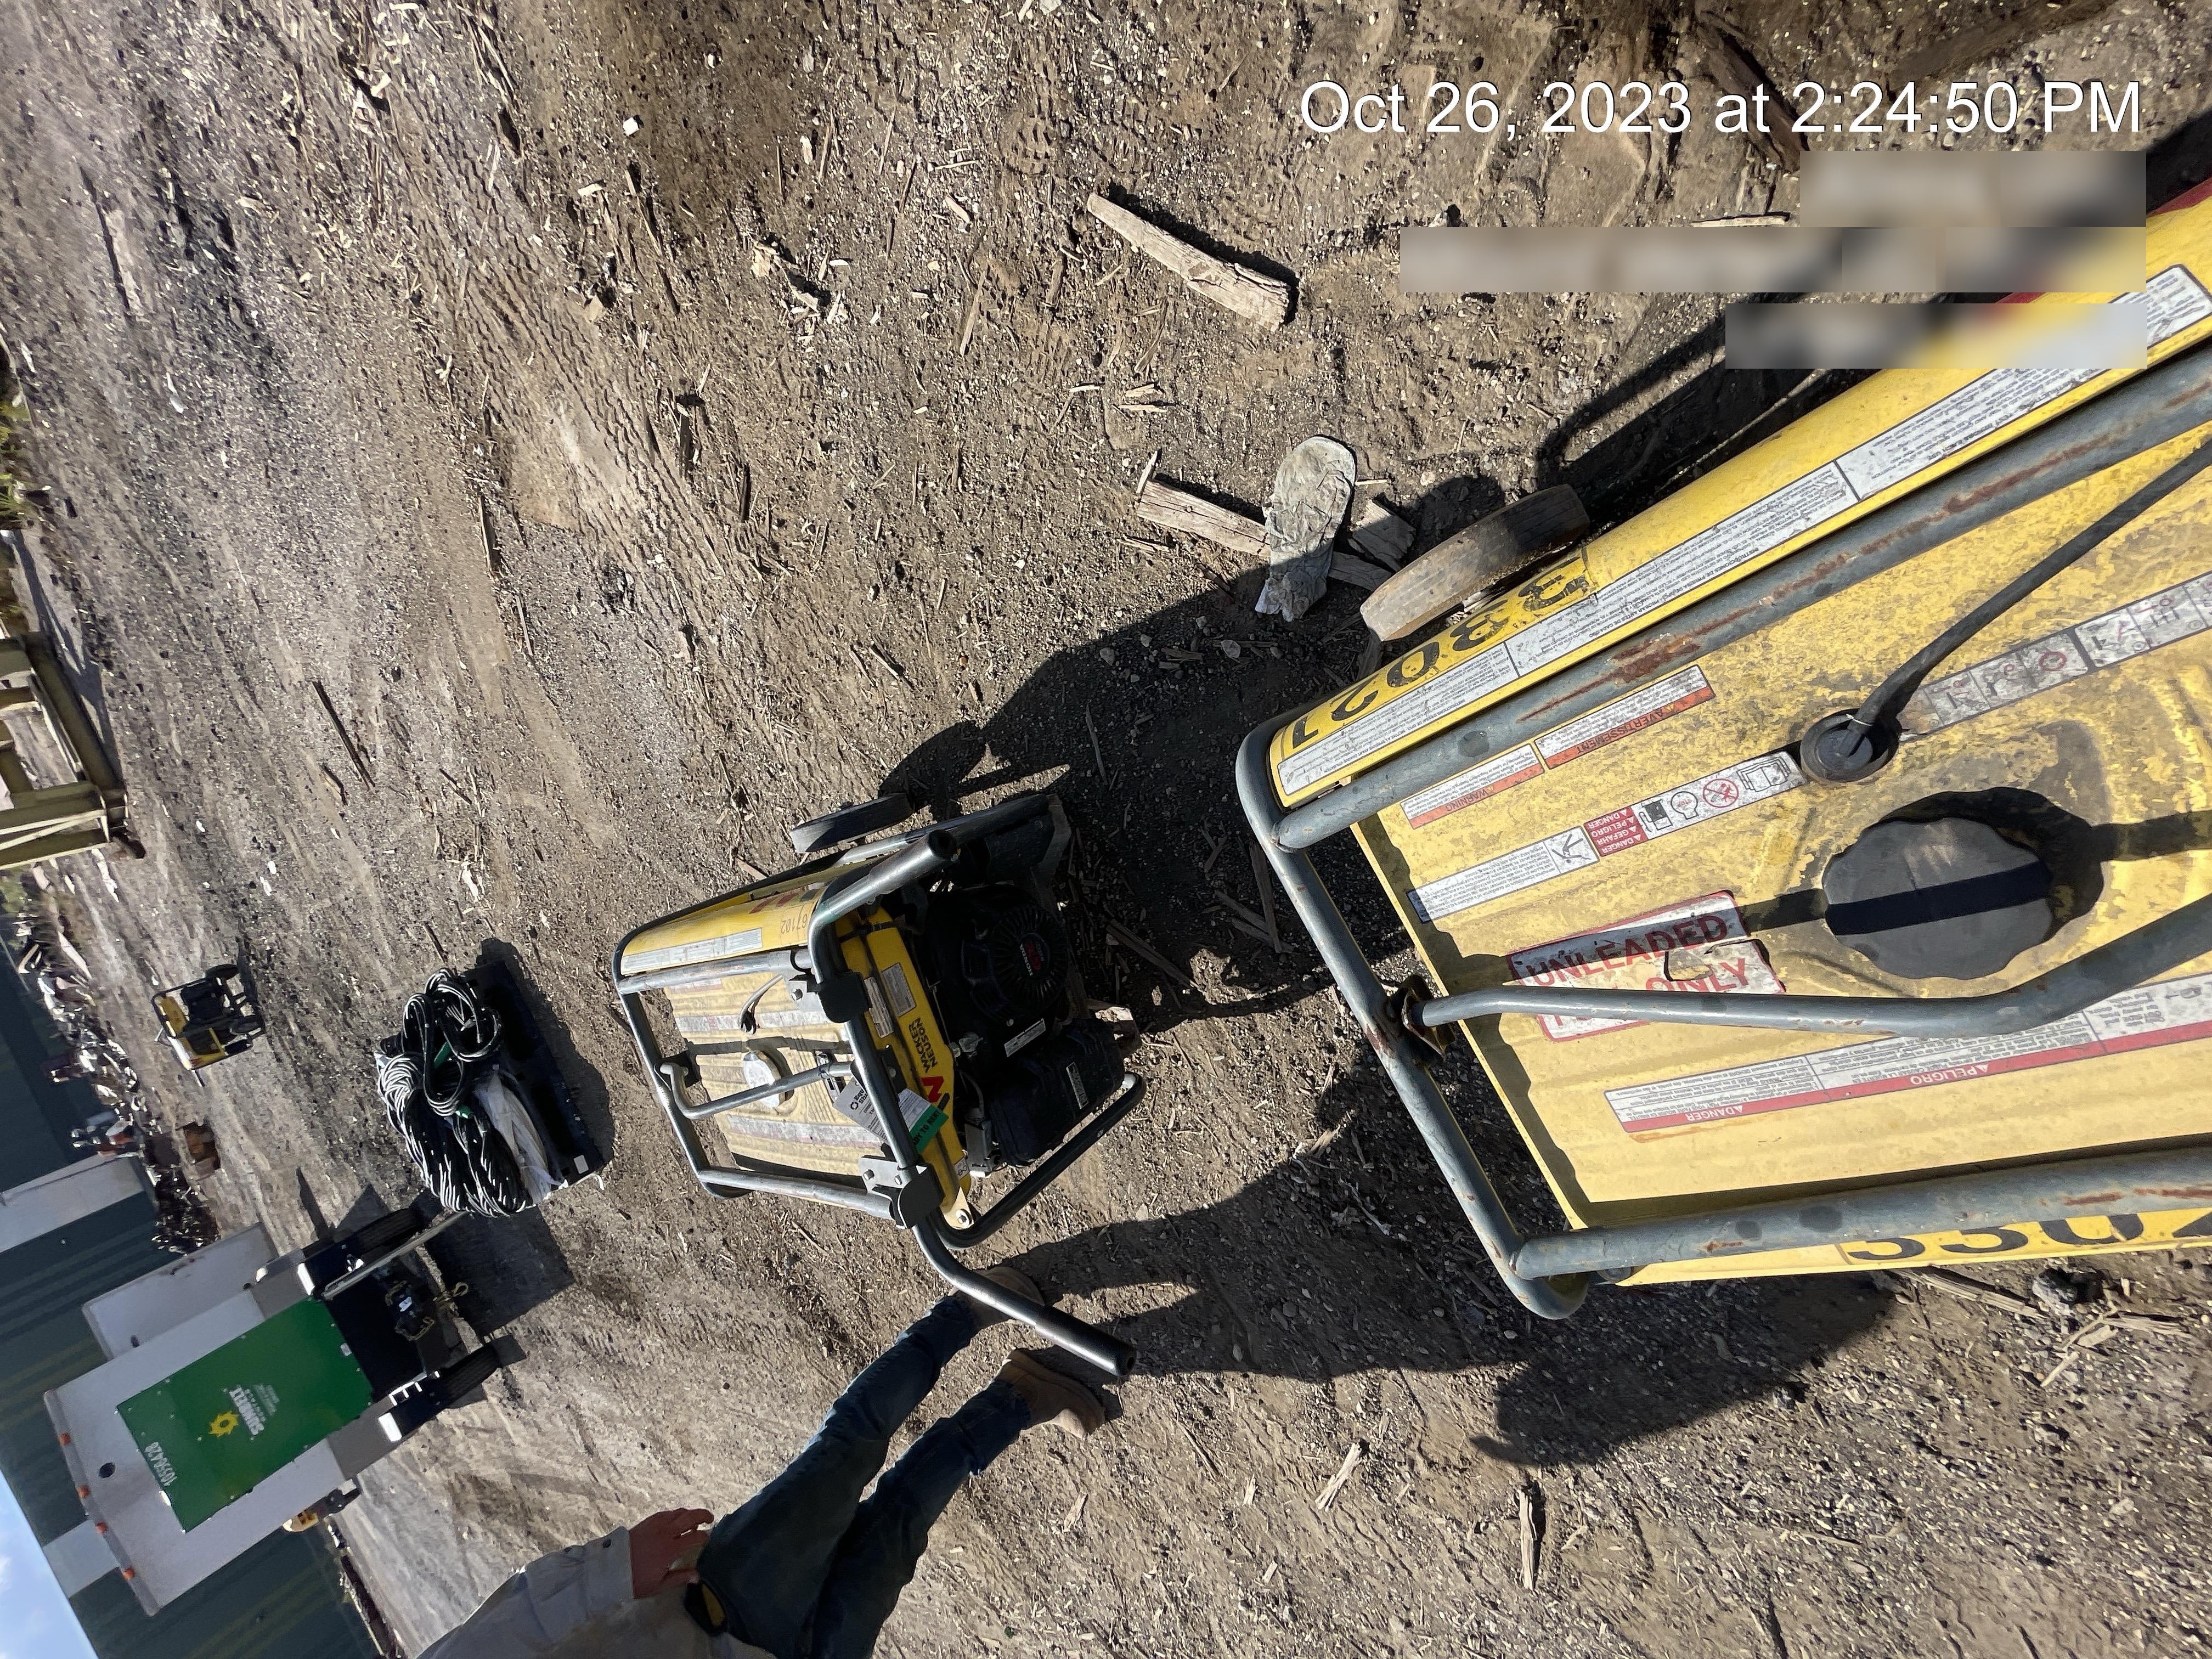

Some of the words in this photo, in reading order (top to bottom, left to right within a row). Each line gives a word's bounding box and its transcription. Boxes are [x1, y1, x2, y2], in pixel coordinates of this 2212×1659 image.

[1291, 556, 1595, 751] 33021
[1444, 788, 1487, 812] WARNING
[1587, 812, 1620, 828] DANGER
[1590, 820, 1627, 837] PELIGRO
[1596, 829, 1628, 845] GEFAHR
[1601, 837, 1633, 853] DANGER
[1525, 911, 1730, 990] UNLEADED
[907, 1021, 932, 1073] WACKER
[914, 1017, 938, 1068] NEUSON
[1909, 1064, 1978, 1086] PELIGRO
[1685, 1105, 1736, 1121] DANGER
[919, 1124, 929, 1133] TO
